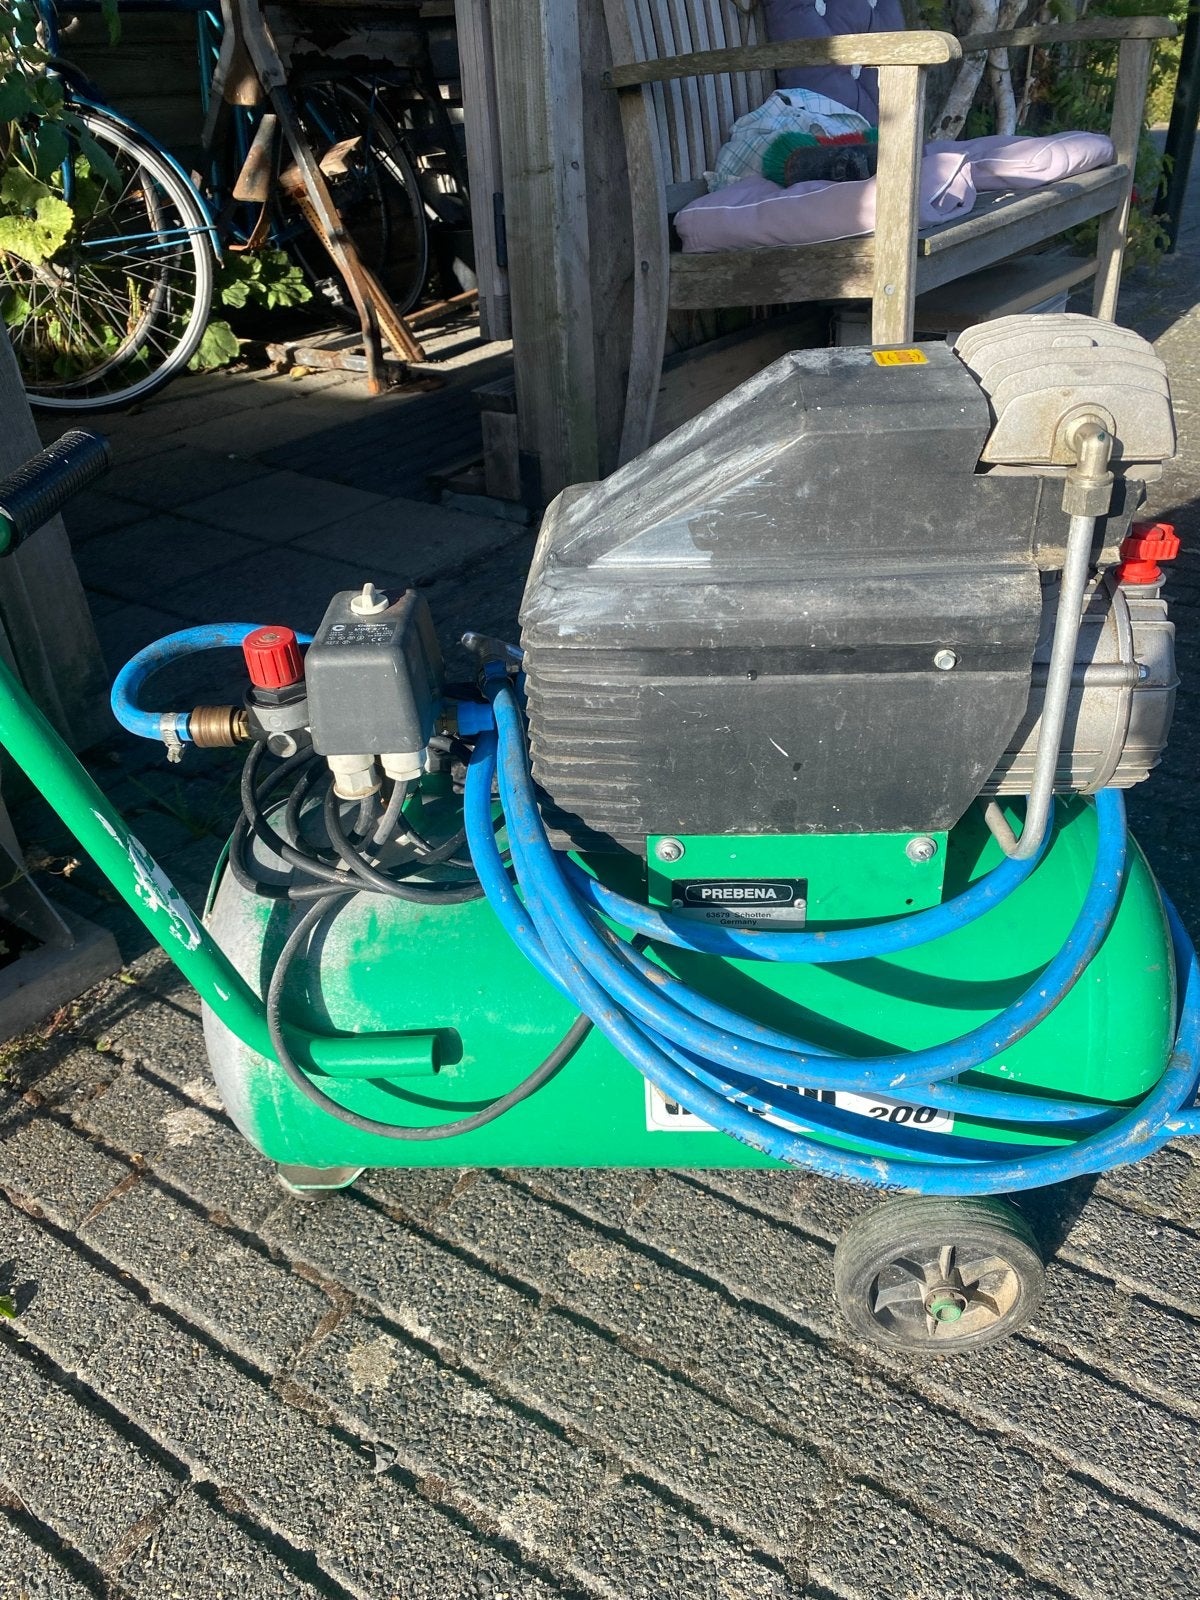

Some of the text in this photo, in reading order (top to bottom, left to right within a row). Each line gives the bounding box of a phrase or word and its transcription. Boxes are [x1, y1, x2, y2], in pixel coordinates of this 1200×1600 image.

[701, 888, 777, 899] PREBENA
[734, 911, 772, 919] Schotten
[720, 918, 757, 926] Germany
[868, 1105, 938, 1124] 200
